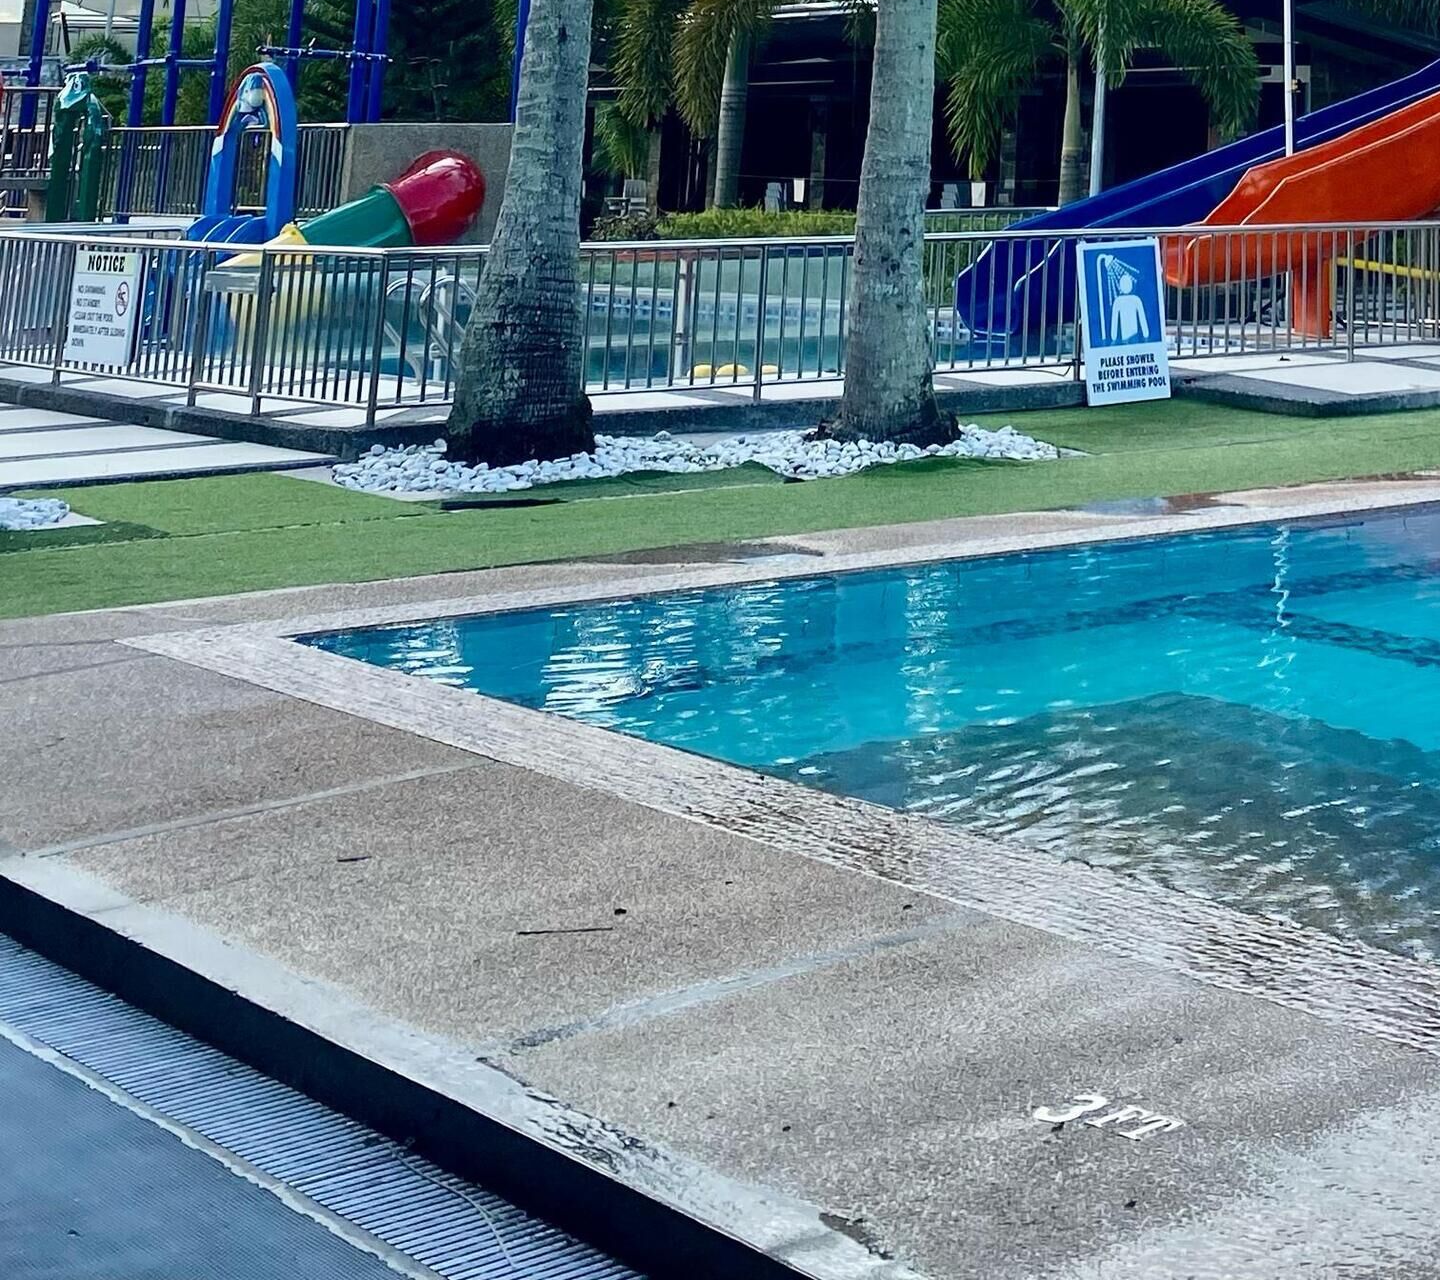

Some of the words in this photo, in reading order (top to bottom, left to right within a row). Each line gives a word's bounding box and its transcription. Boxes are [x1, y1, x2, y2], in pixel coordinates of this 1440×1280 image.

[87, 254, 126, 273] NOTICE
[1100, 355, 1125, 368] PLEASE
[1126, 353, 1156, 365] SHOWER
[1098, 368, 1124, 380] BEFORE
[1126, 364, 1159, 378] ENTERING
[1092, 382, 1106, 394] THE
[1107, 378, 1147, 392] SWIMMING
[1148, 375, 1167, 388] POOL
[1033, 1094, 1108, 1123] 3
[1084, 1104, 1187, 1141] FT
